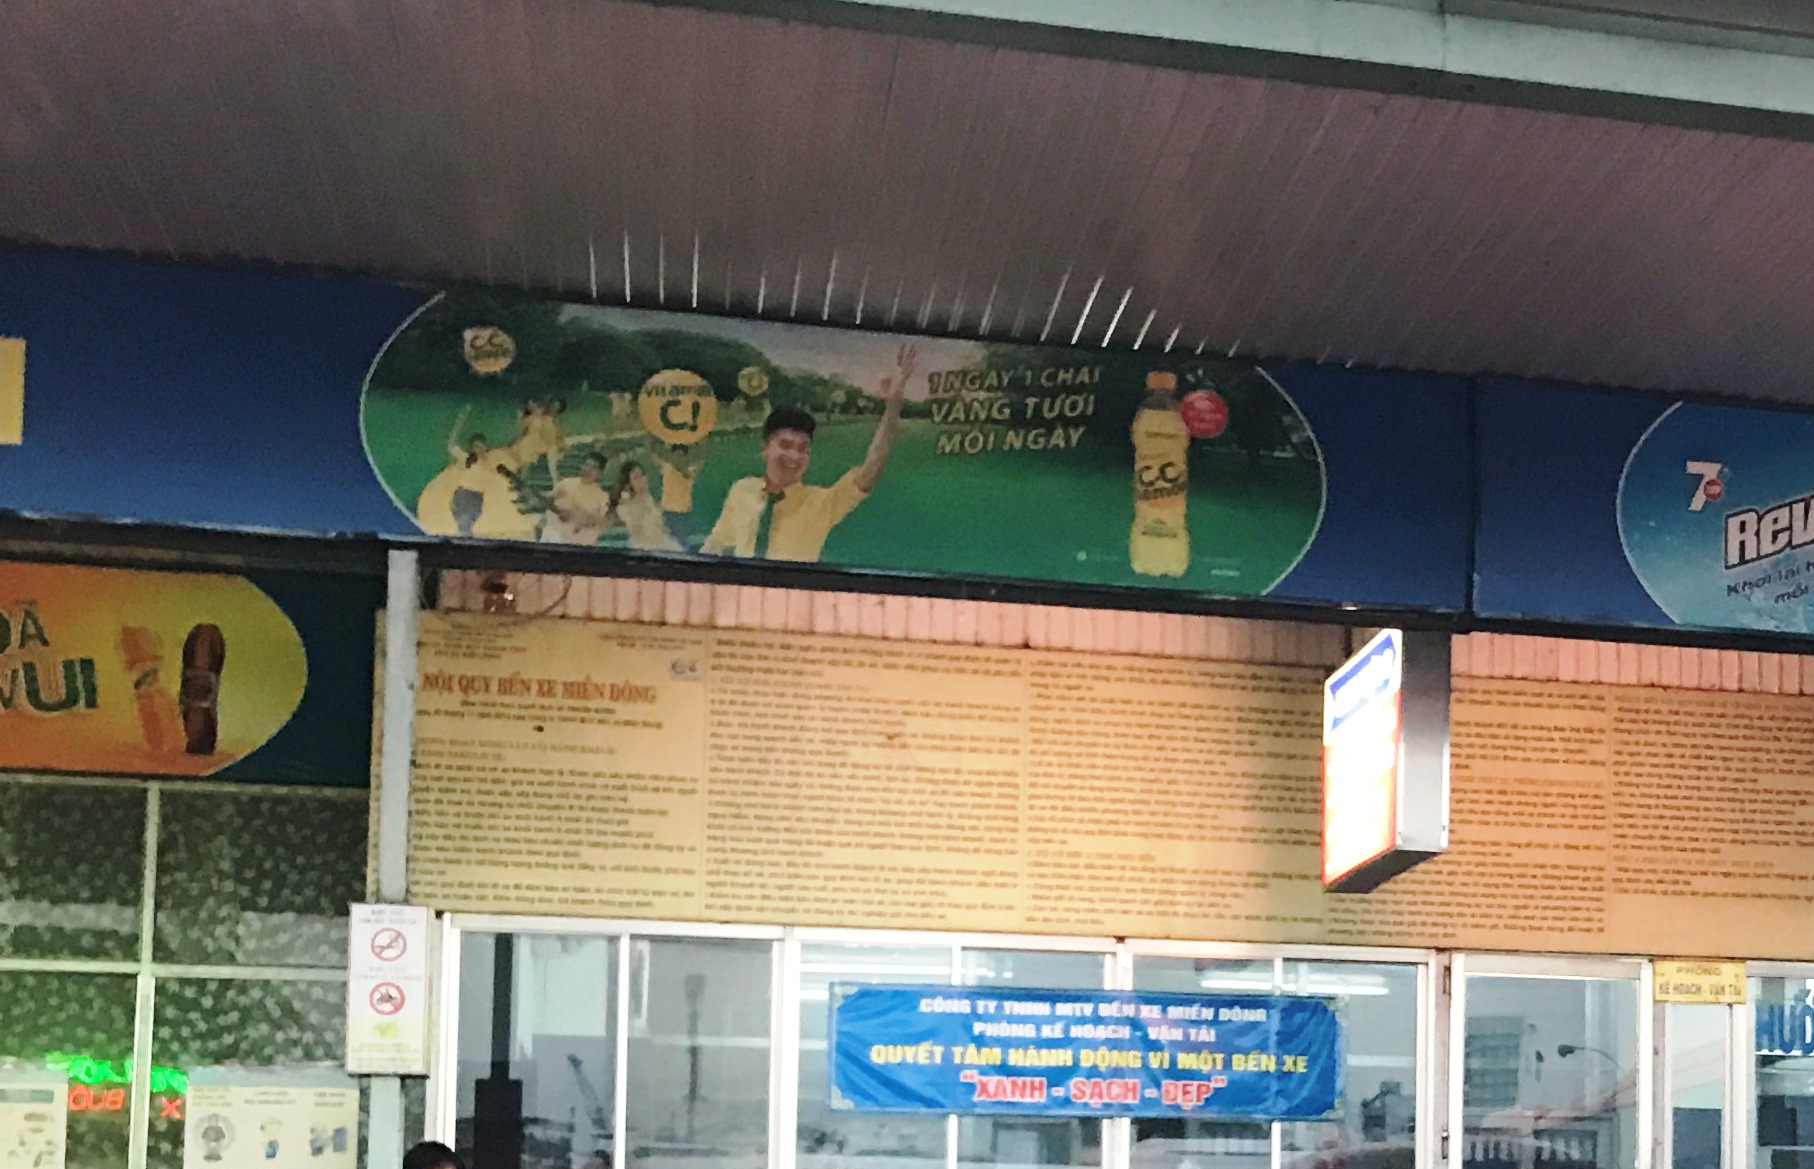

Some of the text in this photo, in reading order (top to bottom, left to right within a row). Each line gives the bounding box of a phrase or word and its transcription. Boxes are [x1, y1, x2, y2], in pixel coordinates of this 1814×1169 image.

[1041, 364, 1101, 387] CHAI
[458, 674, 491, 696] QUY
[536, 677, 557, 699] XE
[919, 995, 972, 1014] CÔNG
[976, 999, 998, 1015] TY
[1003, 1000, 1051, 1016] TNHH
[1055, 1001, 1095, 1017] MTV
[1098, 1000, 1136, 1018] BẾN
[1139, 1004, 1163, 1019] XE
[973, 1020, 1037, 1038] PHÒNG
[1040, 1019, 1066, 1038] KẾ
[869, 1039, 945, 1065] QUYẾT
[951, 1043, 1002, 1065] TÂM
[1007, 1045, 1074, 1067] HÀNH
[1079, 1045, 1143, 1071] ĐỘNG
[1176, 1049, 1226, 1074] MỘT
[1231, 1049, 1277, 1072] BẾN
[1281, 1054, 1309, 1073] XE
[1070, 1077, 1141, 1107] SẠCH
